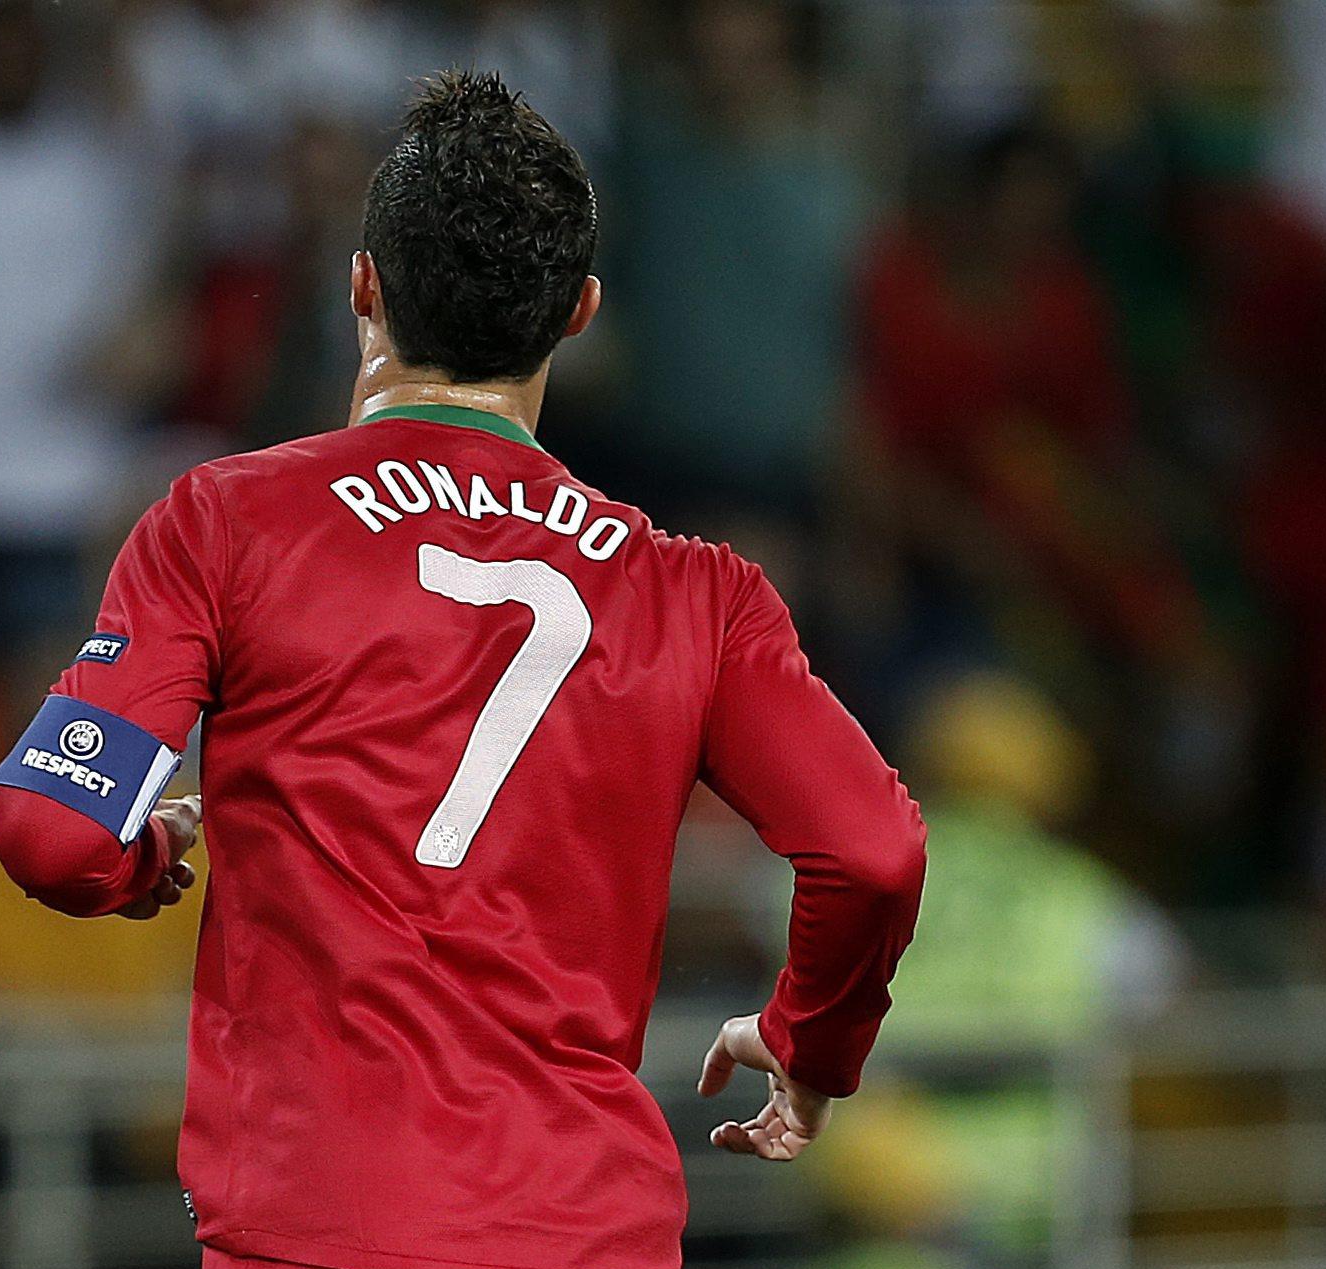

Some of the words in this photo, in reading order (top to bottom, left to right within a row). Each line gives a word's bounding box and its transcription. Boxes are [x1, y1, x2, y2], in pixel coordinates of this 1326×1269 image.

[330, 460, 630, 561] RONALDO
[416, 543, 592, 868] 7
[21, 747, 116, 798] RESPECT
